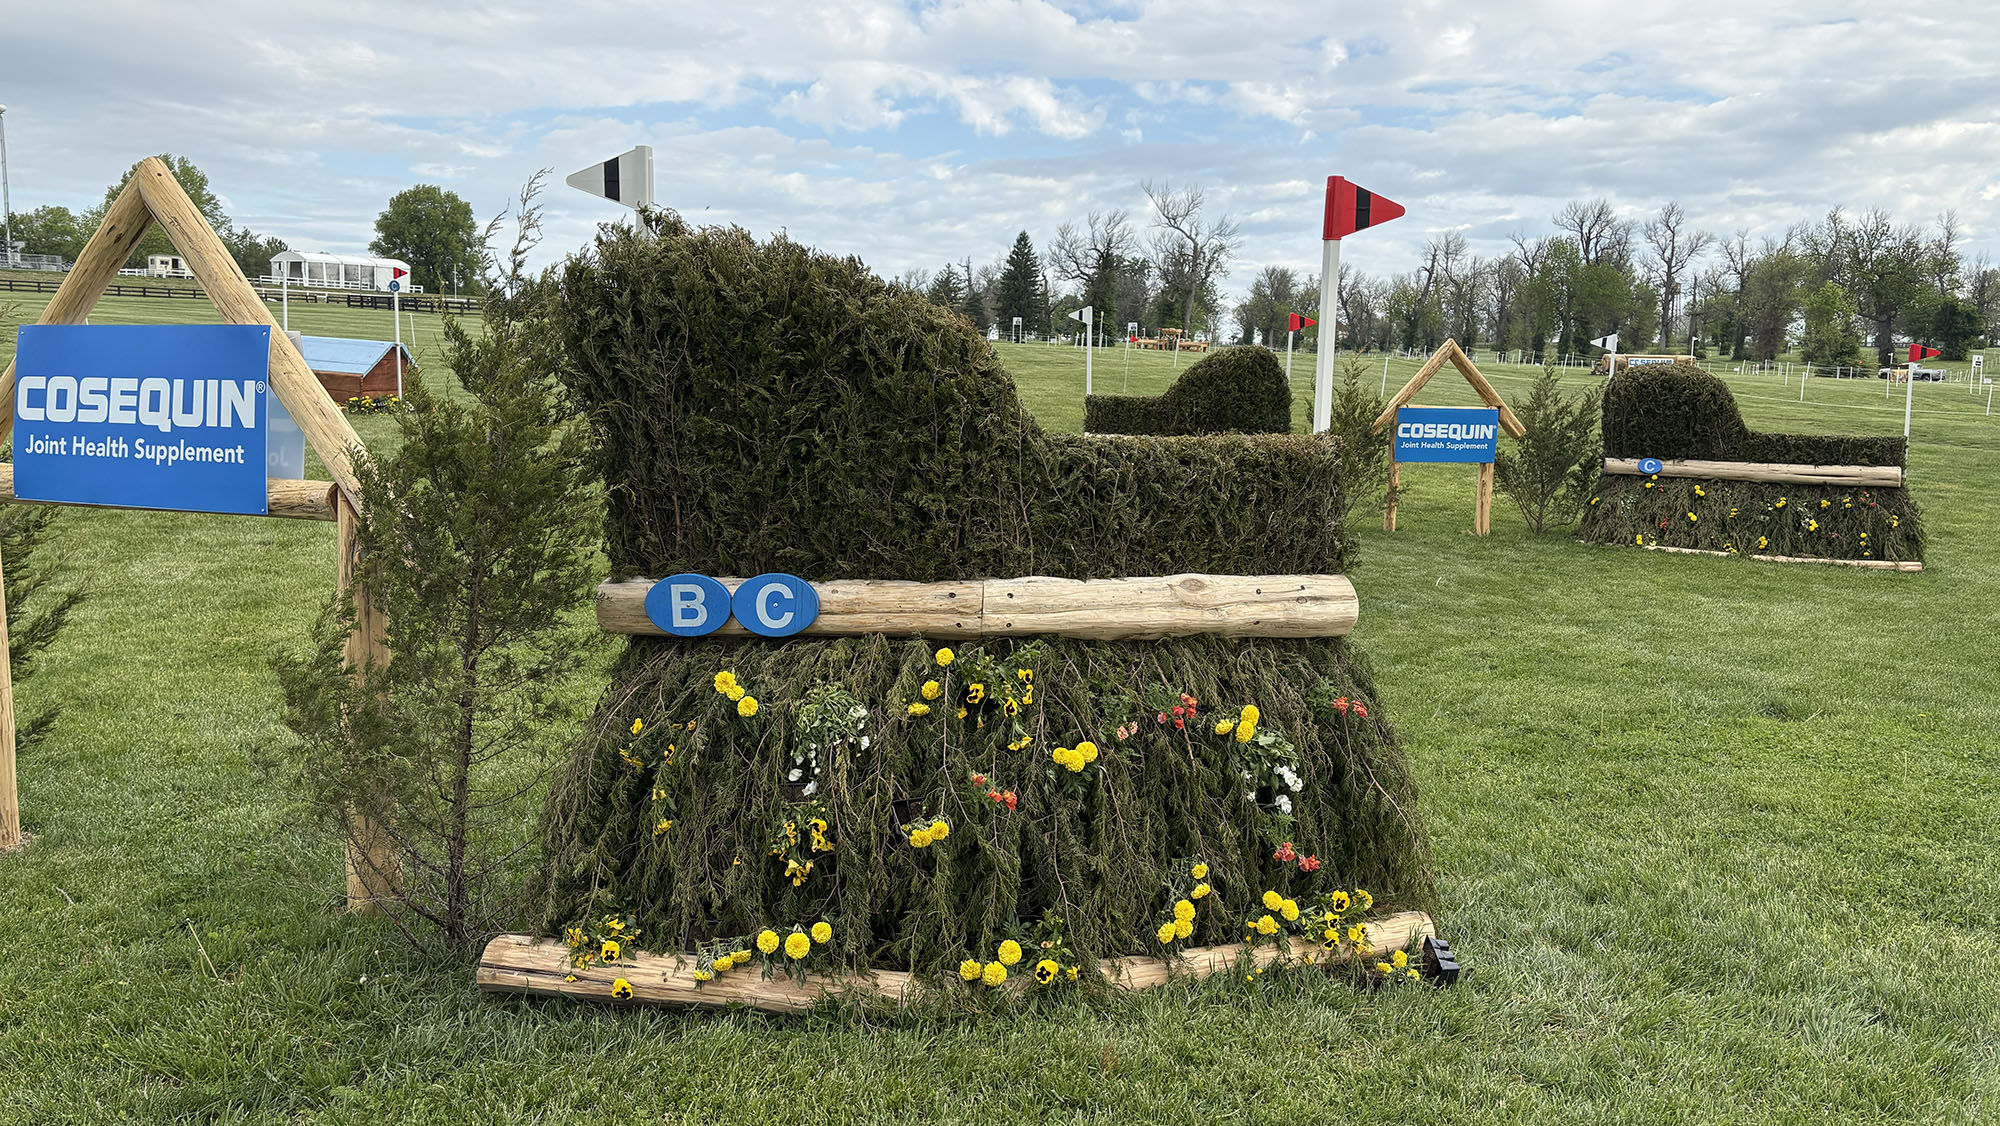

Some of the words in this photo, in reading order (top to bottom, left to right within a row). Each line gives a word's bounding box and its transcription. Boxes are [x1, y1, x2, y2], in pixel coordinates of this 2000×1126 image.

[25, 434, 67, 455] Joint
[72, 436, 129, 458] Health
[134, 438, 245, 466] Supplement
[1446, 442, 1488, 451] Supplement
[1644, 460, 1656, 472] C
[670, 583, 708, 628] B
[755, 582, 794, 629] C
